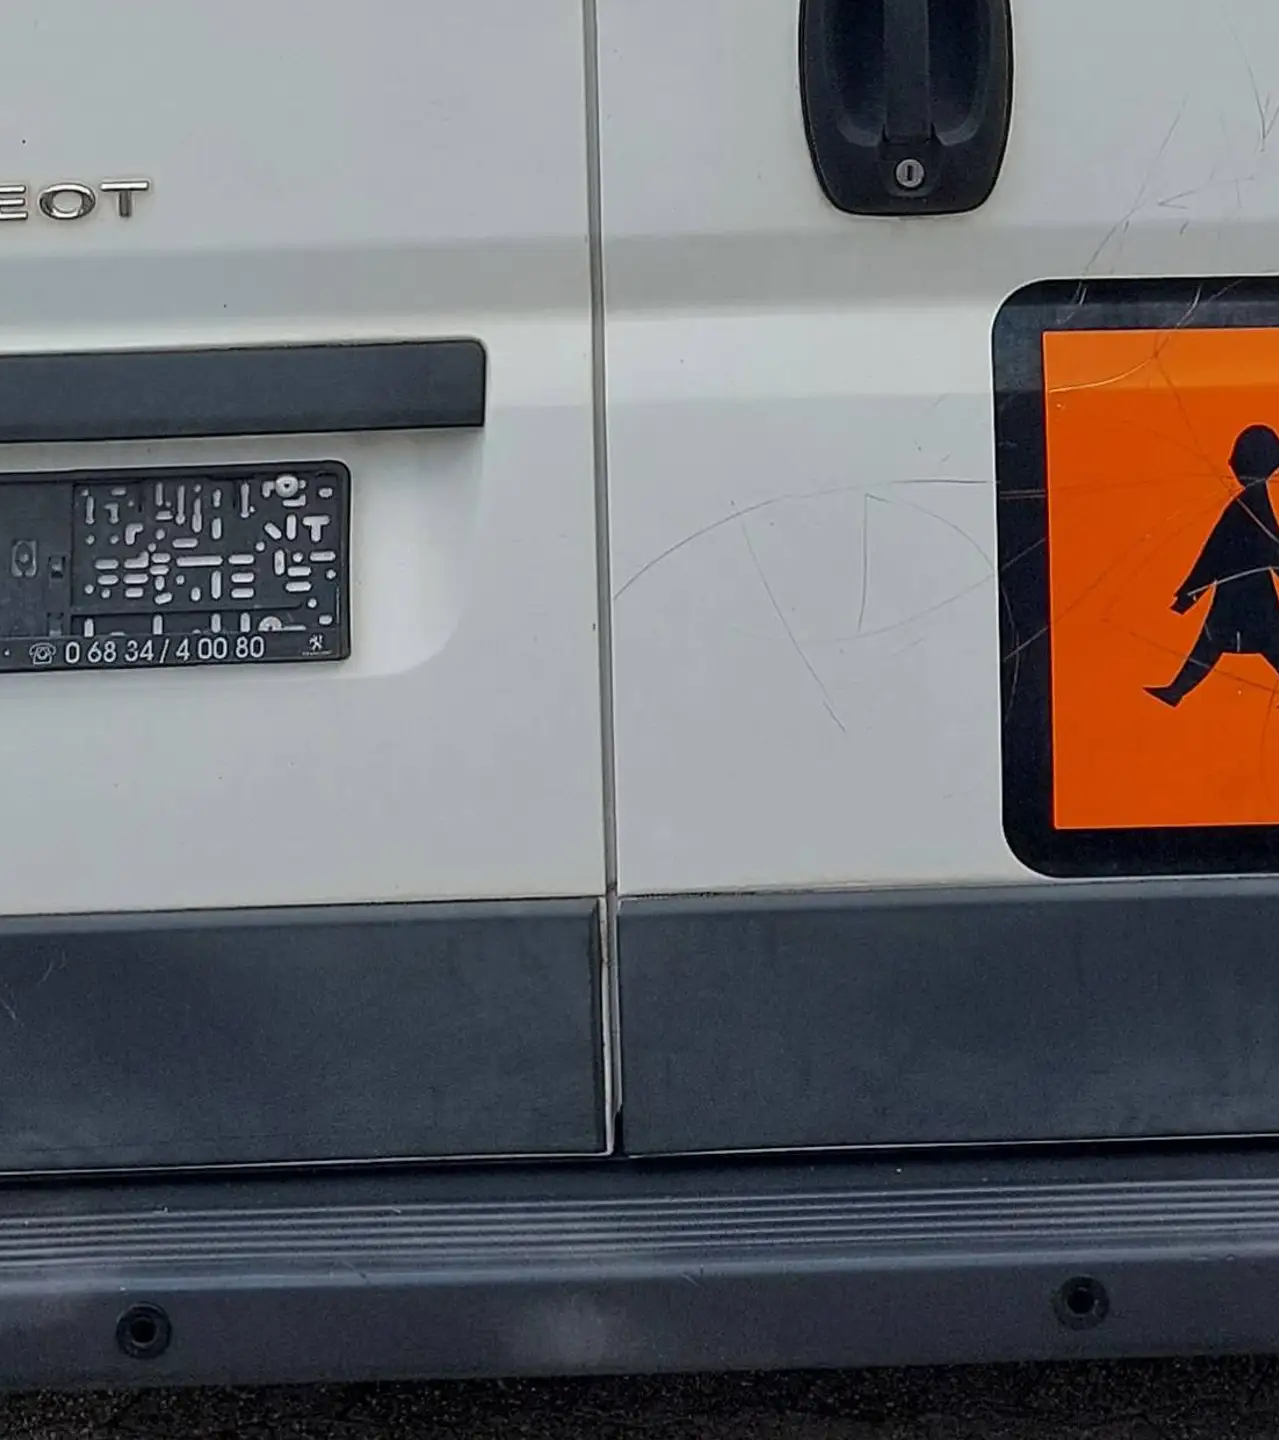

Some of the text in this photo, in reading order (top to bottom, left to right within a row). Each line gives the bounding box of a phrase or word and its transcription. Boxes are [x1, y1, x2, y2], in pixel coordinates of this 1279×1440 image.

[64, 641, 80, 664] 0
[87, 640, 117, 663] 68
[198, 636, 228, 660] 00
[236, 635, 266, 659] 80
